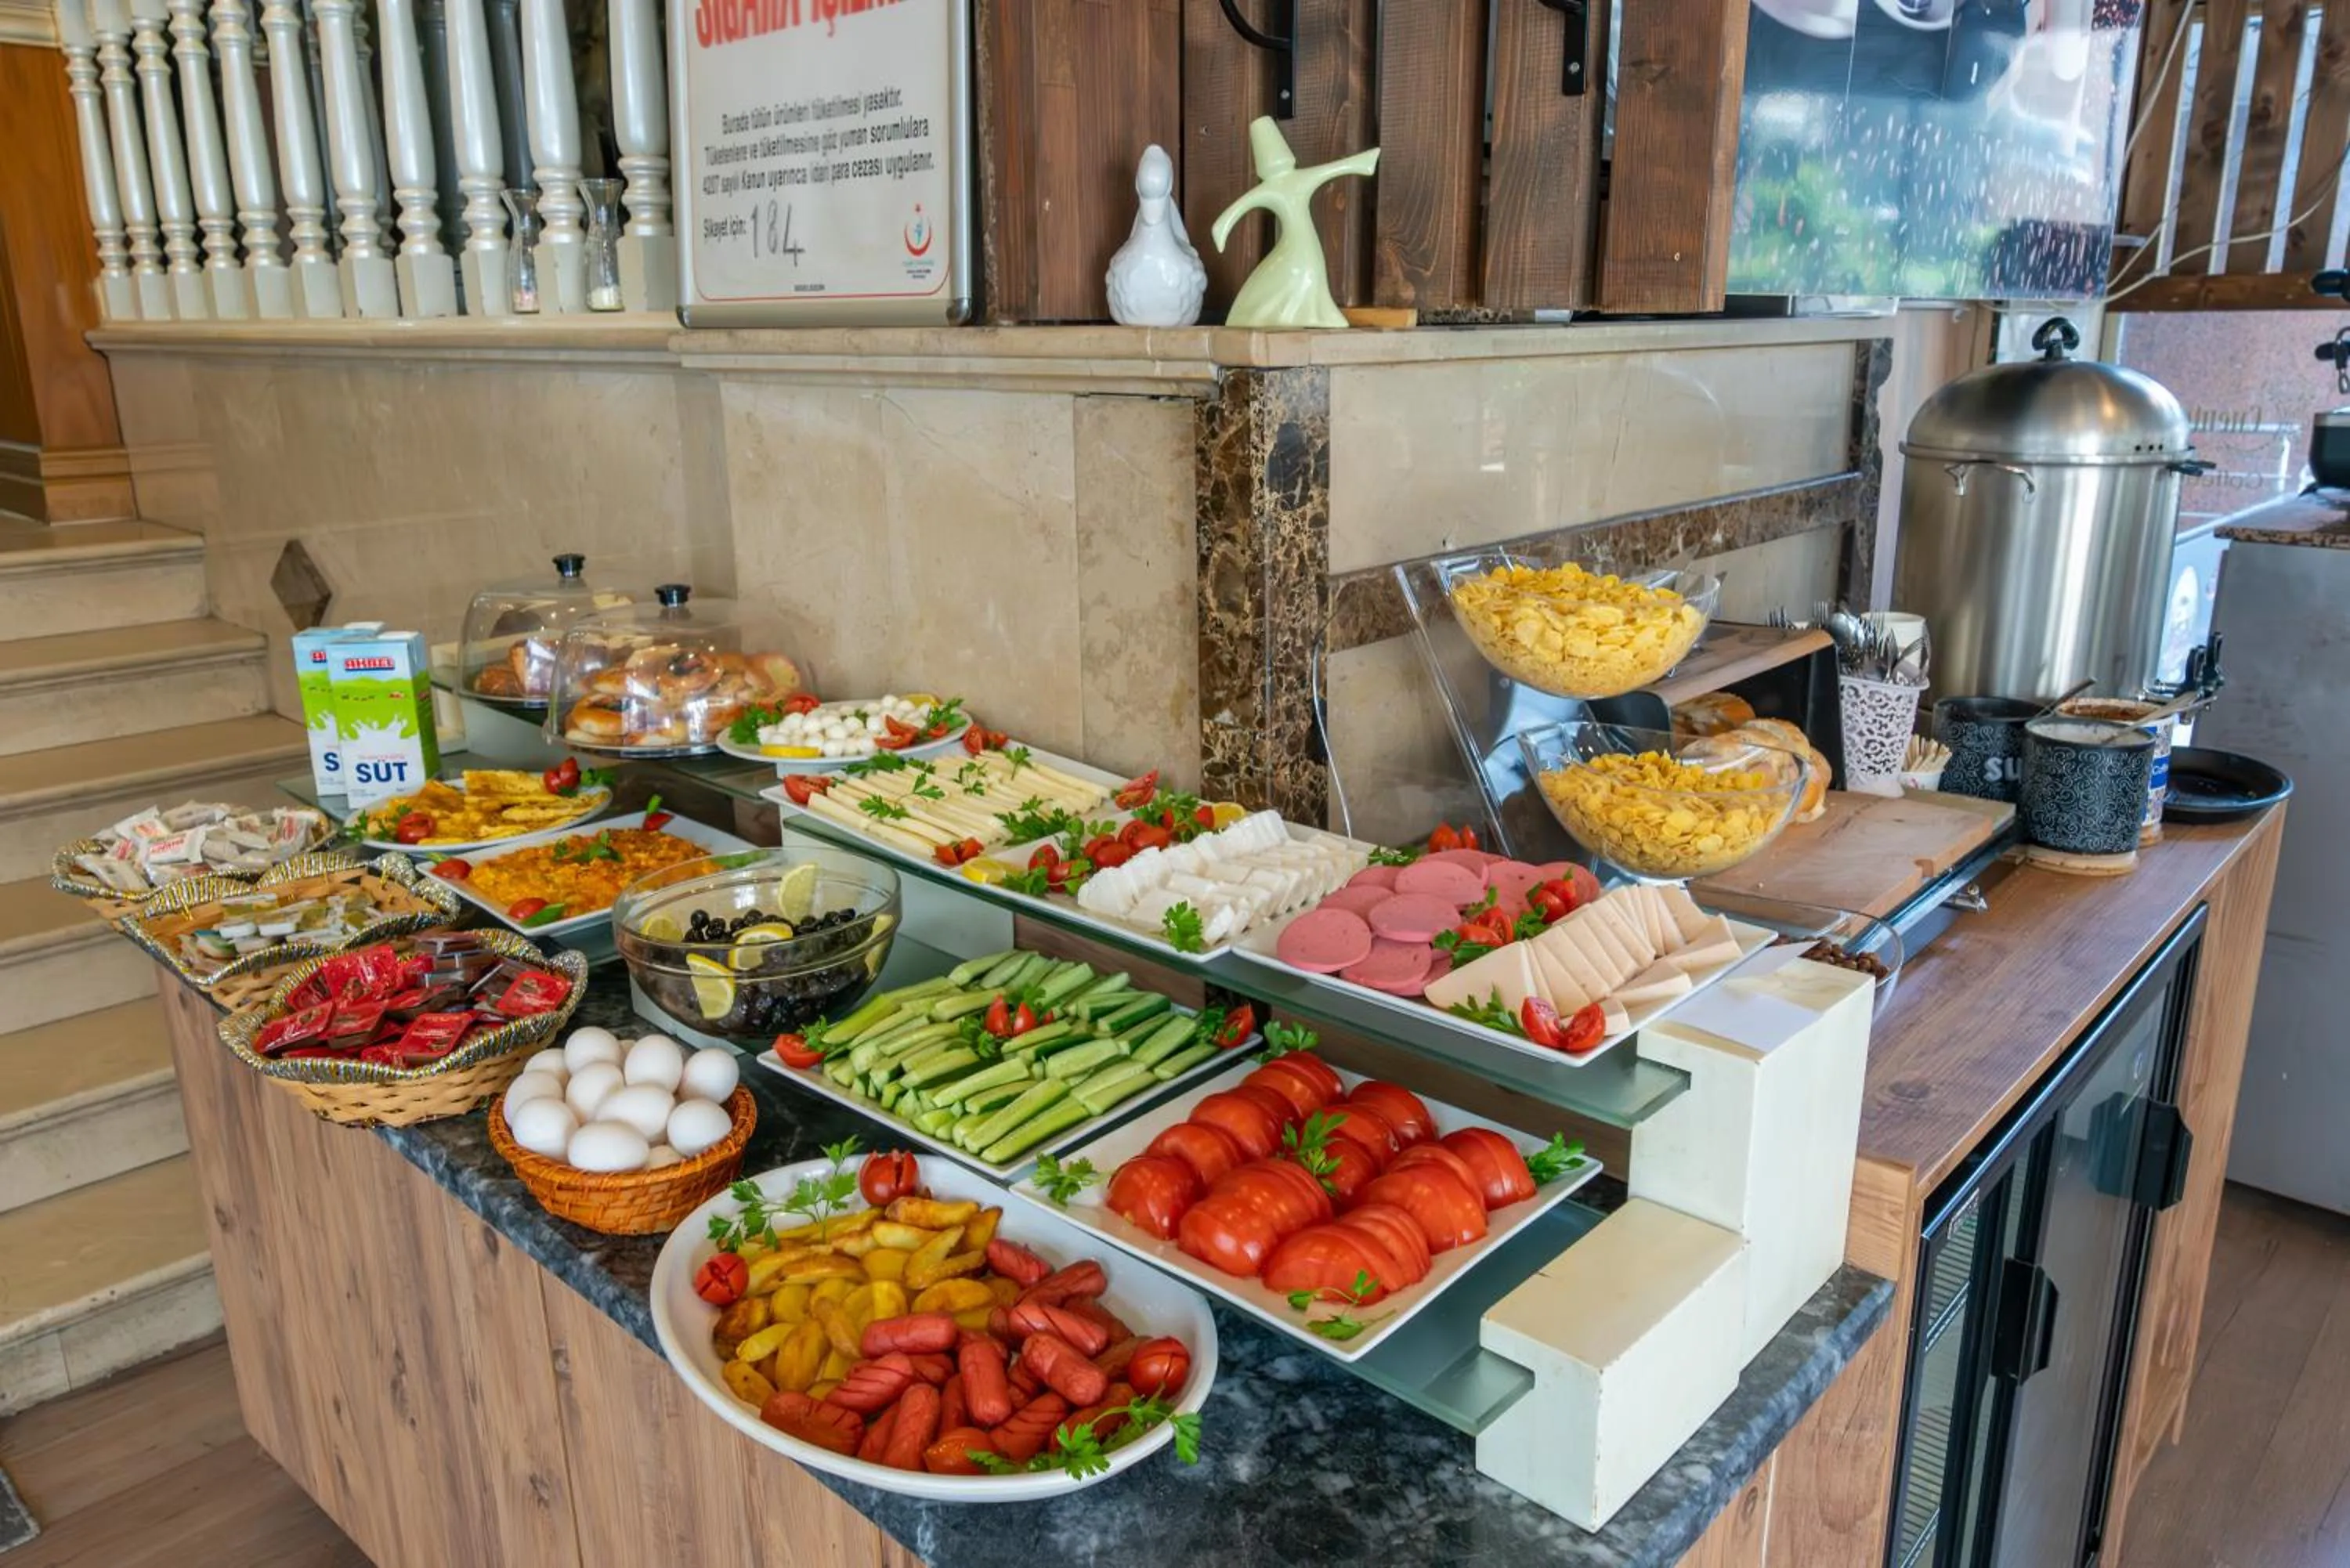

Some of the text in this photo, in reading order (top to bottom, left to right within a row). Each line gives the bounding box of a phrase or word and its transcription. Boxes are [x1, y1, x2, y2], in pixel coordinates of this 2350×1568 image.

[862, 86, 902, 119] yasaktır.
[839, 127, 867, 154] yuman
[870, 115, 929, 143] sorumlulara
[740, 169, 766, 190] Kanun
[768, 167, 807, 193] uyarınca
[831, 162, 851, 186] para
[851, 157, 883, 179] cezası
[885, 150, 935, 180] uygulanır.
[750, 199, 806, 267] 184
[355, 759, 408, 783] SÜT
